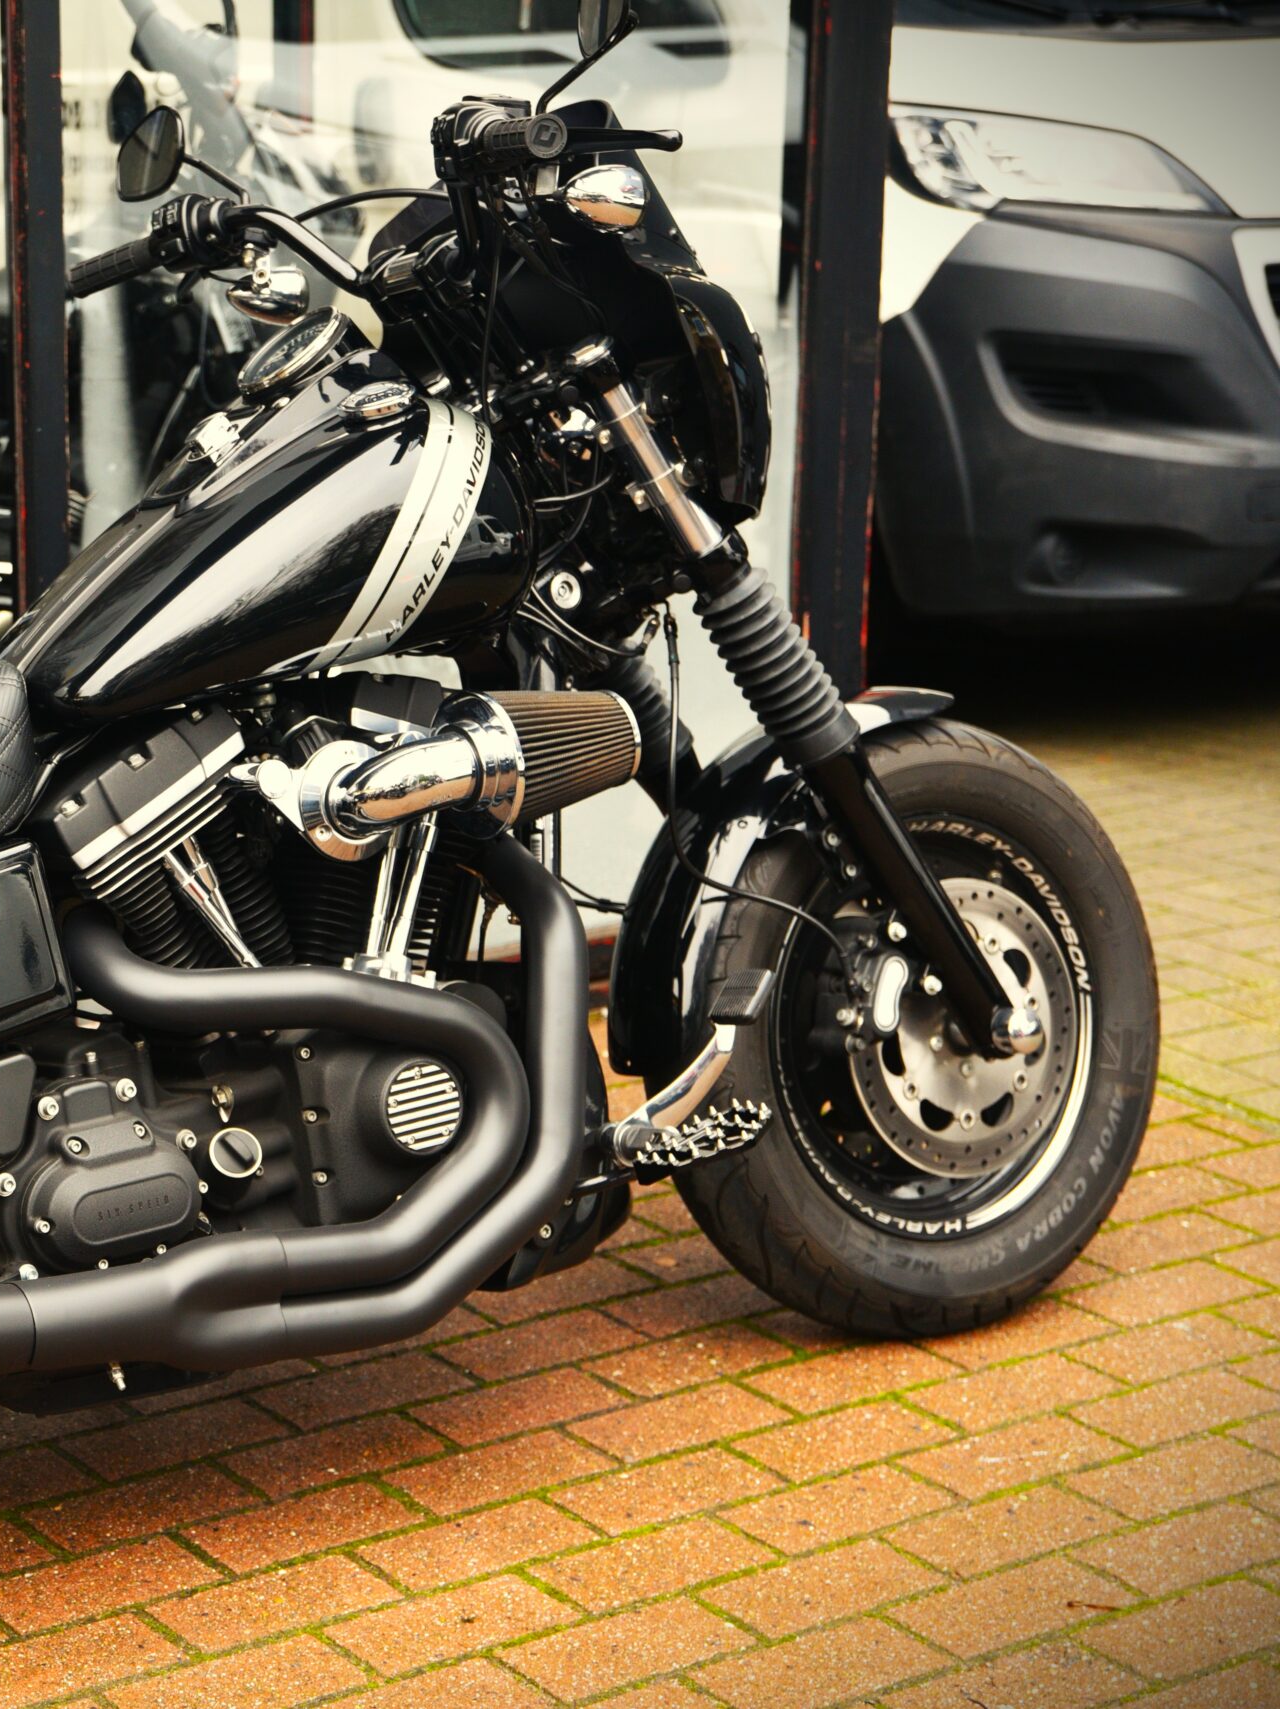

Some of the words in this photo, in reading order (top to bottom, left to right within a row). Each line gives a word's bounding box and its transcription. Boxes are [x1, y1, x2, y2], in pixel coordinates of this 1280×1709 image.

[386, 421, 487, 643] HARLEY-DAVIDSO
[909, 821, 1092, 992] HARLEY-DAVIDSON
[1088, 1086, 1124, 1175] AVON
[128, 1195, 170, 1214] SPEED
[1015, 1177, 1087, 1251] COBRA
